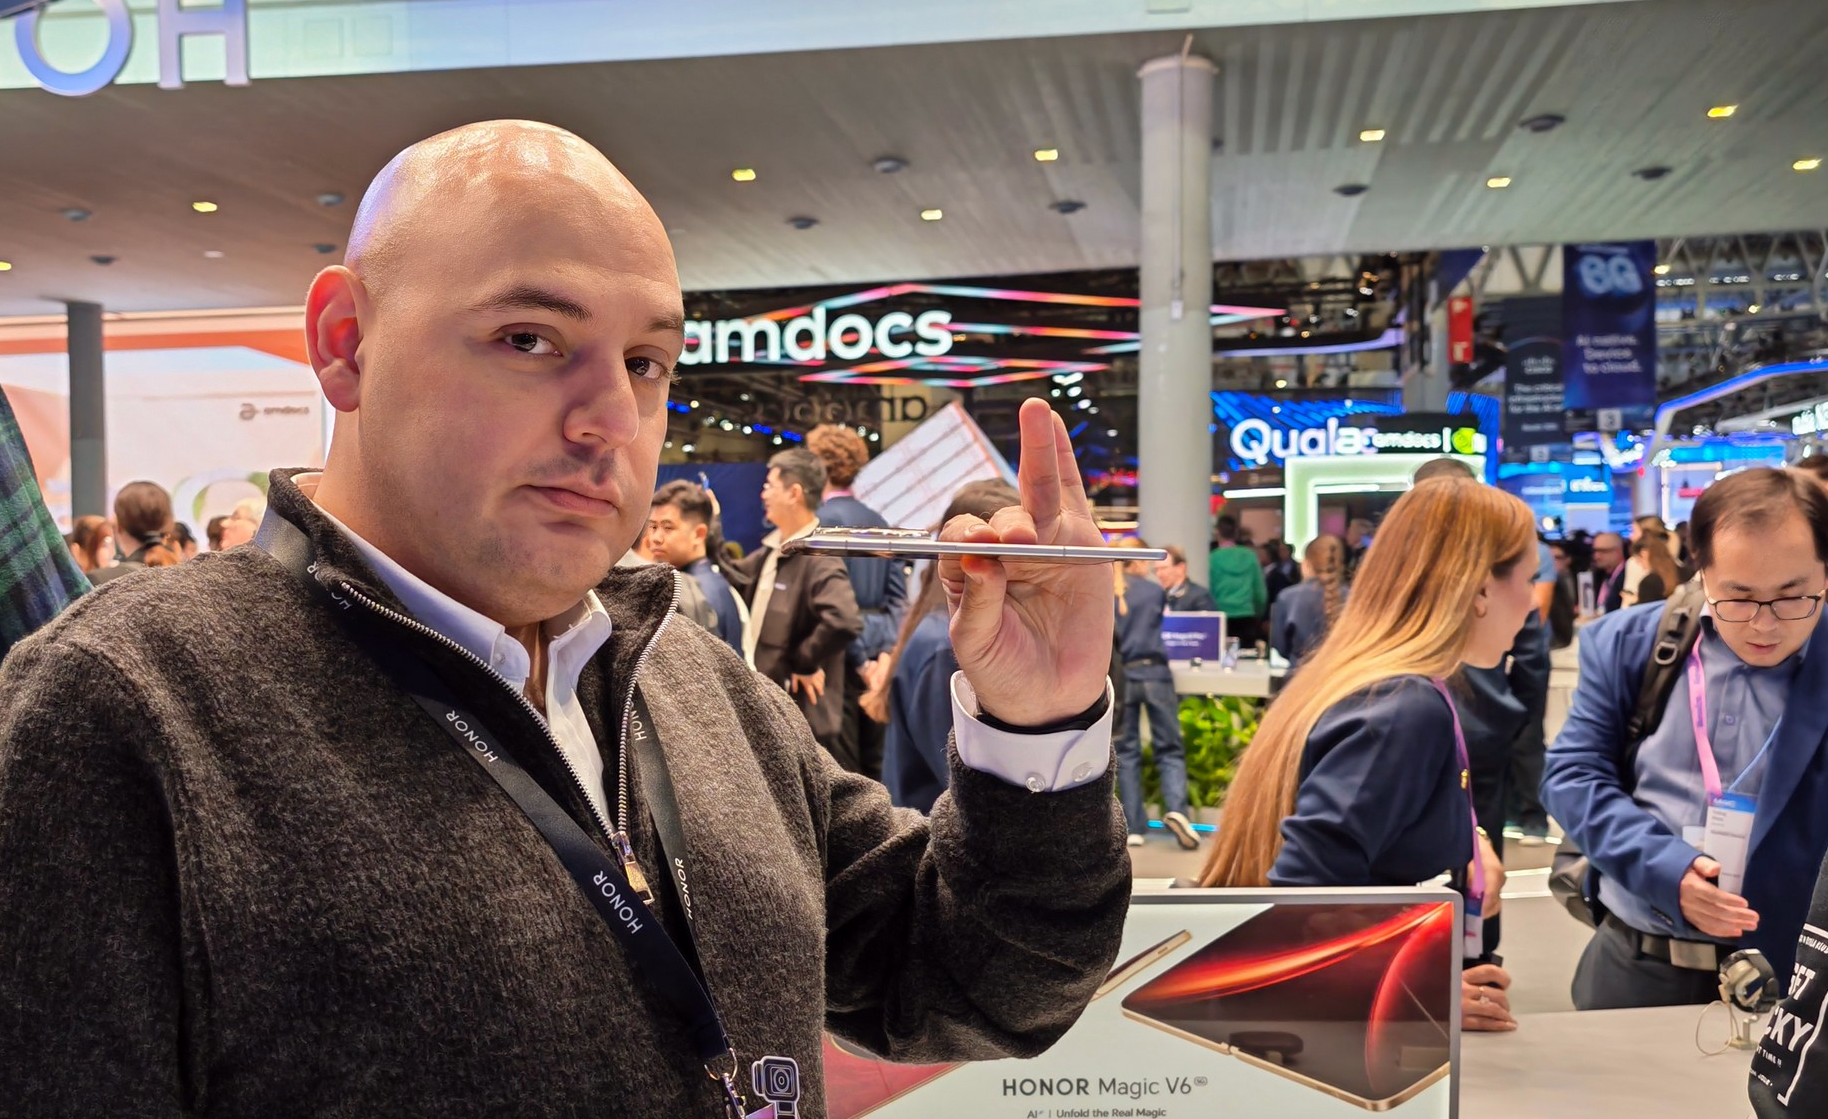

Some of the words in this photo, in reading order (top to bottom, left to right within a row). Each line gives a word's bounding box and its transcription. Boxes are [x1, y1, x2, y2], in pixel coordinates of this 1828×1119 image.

[677, 305, 954, 366] amdocs
[445, 710, 499, 763] HONOR
[593, 870, 643, 934] HONOR
[674, 857, 694, 920] HONOR
[1002, 1077, 1090, 1096] HONOR
[1098, 1076, 1160, 1099] Magic
[1165, 1076, 1192, 1095] V6
[1056, 1108, 1090, 1118] Unfold
[1092, 1108, 1109, 1118] the
[1111, 1107, 1133, 1118] Real
[1136, 1107, 1167, 1119] Magic
